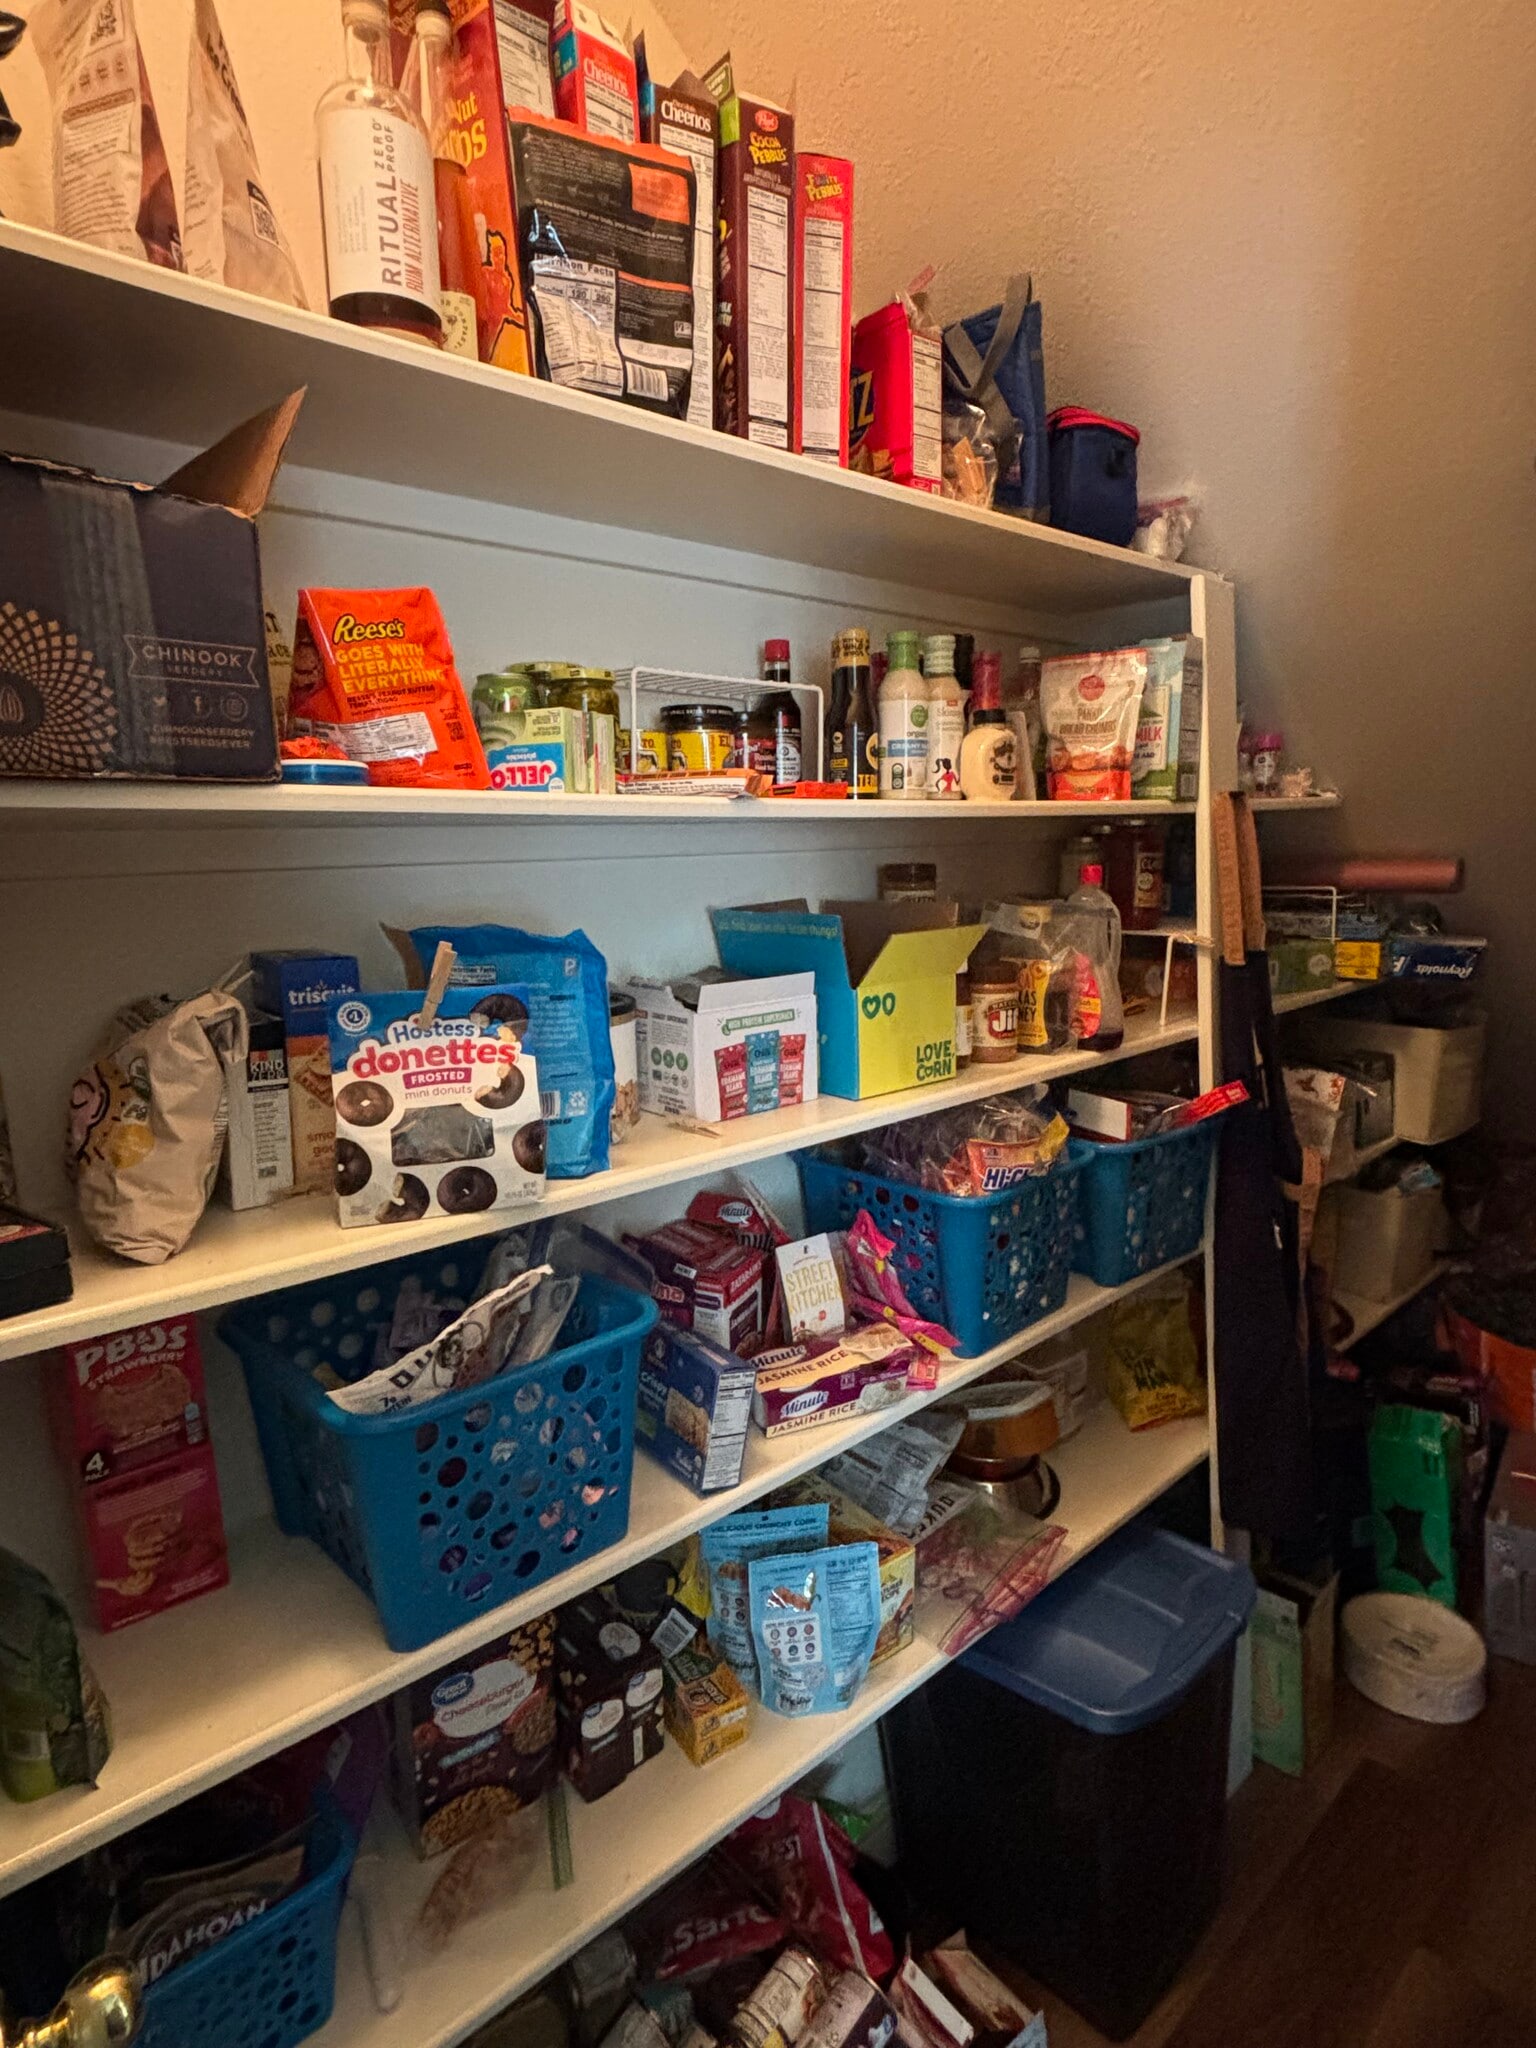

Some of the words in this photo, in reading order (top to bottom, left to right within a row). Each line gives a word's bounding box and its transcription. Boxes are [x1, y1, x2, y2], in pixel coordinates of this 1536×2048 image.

[584, 57, 629, 96] Cheerios
[661, 100, 711, 132] Cheerios
[373, 119, 385, 170] ZERO
[384, 126, 395, 172] PROOF
[377, 175, 402, 286] RITUAL
[401, 179, 422, 264] ALTERNATIVE
[405, 266, 424, 294] RUM
[588, 263, 614, 277] Facts
[333, 614, 405, 645] Reese's
[142, 645, 242, 667] CHINOOK
[336, 645, 384, 663] GOES
[387, 643, 425, 656] WITH
[340, 657, 424, 678] LITERALLY
[342, 669, 446, 694] EVERYTHING
[1415, 963, 1473, 979] Reynolds
[288, 984, 355, 1006] trisc
[394, 1021, 475, 1043] Hostess
[251, 1060, 285, 1073] KIND
[352, 1040, 517, 1079] donettes
[411, 1070, 466, 1085] FROSTED
[405, 1087, 430, 1100] mini
[432, 1085, 473, 1097] donuts
[786, 1262, 833, 1291] STREET
[787, 1284, 842, 1314] KITCHEN
[751, 1345, 805, 1368] Minute
[758, 1363, 814, 1385] JASMINE
[817, 1350, 849, 1369] RICE
[88, 1352, 185, 1390] STRAWBERRY
[784, 1391, 828, 1416] Minute
[772, 1413, 825, 1434] JASMINE
[829, 1402, 857, 1418] RICE
[86, 1452, 104, 1472] 4
[139, 1899, 266, 1984] IDAHOAN
